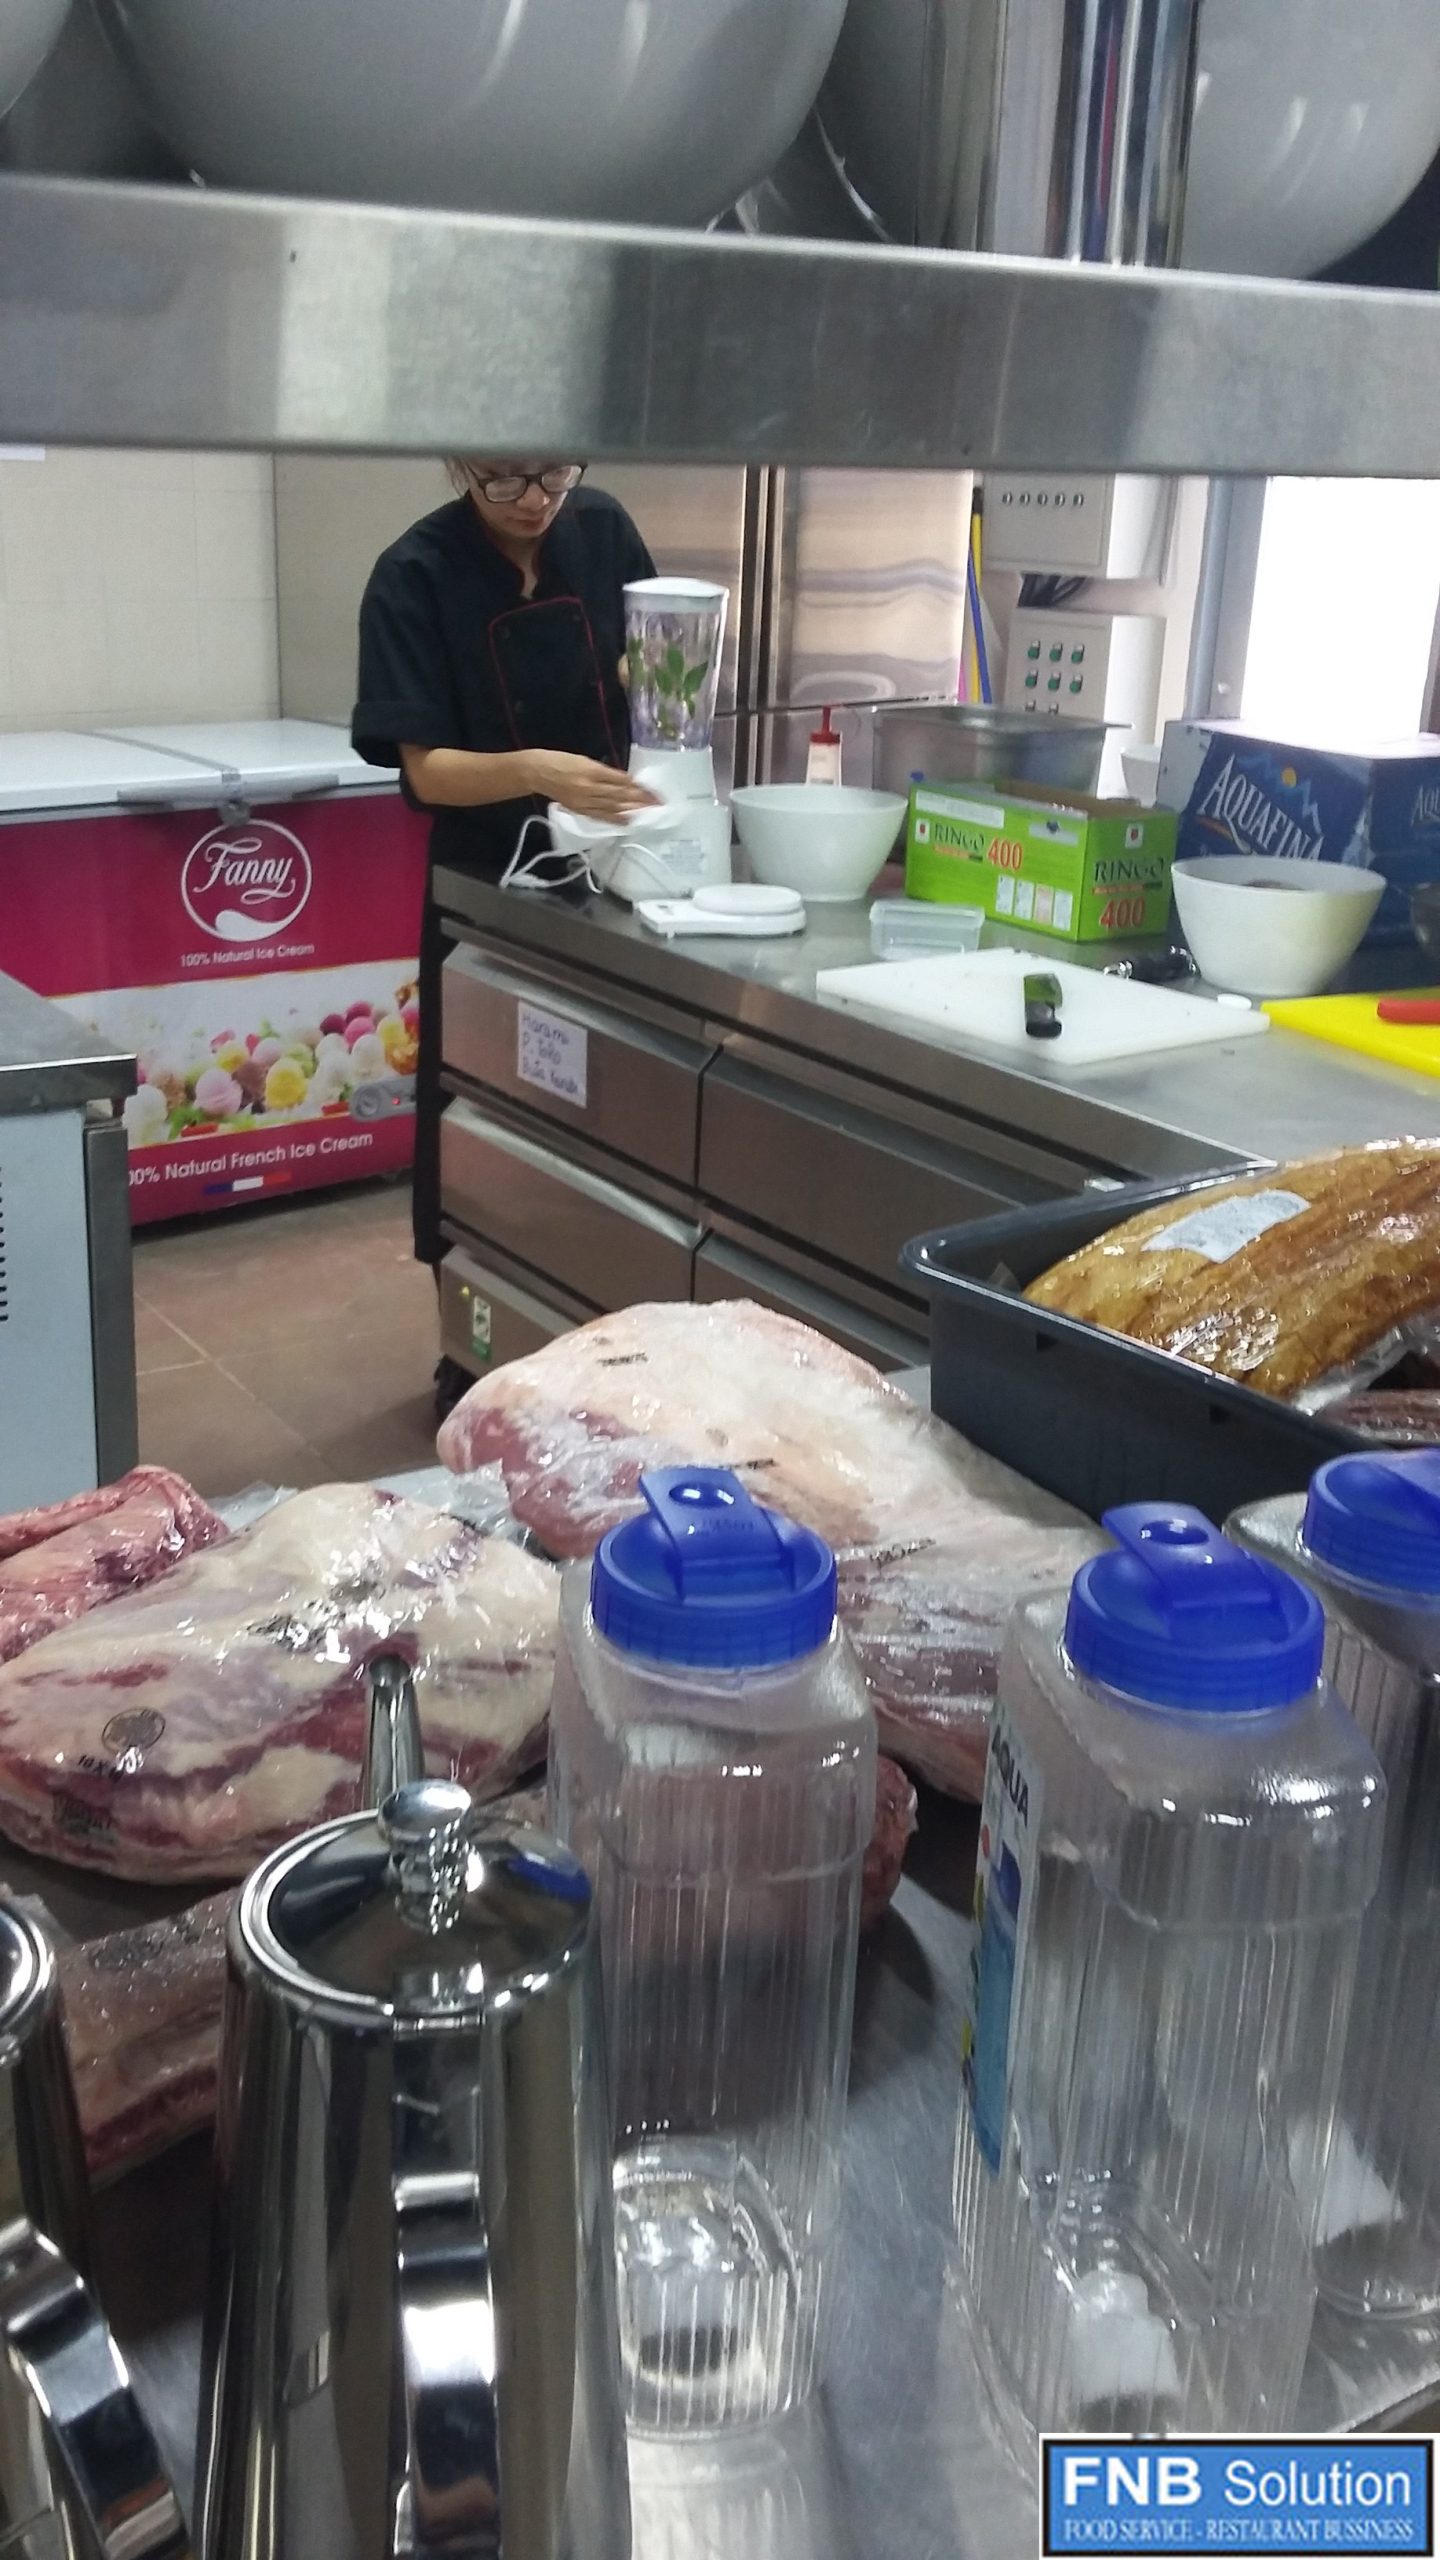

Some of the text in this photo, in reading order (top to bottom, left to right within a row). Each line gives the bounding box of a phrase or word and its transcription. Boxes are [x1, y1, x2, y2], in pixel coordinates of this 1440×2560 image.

[934, 823, 985, 850] RINGO
[987, 836, 1023, 872] 400
[193, 837, 296, 905] Fanny
[1094, 857, 1165, 883] RINGO
[1099, 895, 1146, 929] 400
[180, 944, 315, 967] 100% Natural Ice Cream
[165, 1155, 226, 1179] Natural
[231, 1146, 286, 1170] French
[290, 1141, 316, 1159] Ice
[320, 1133, 373, 1154] Cream
